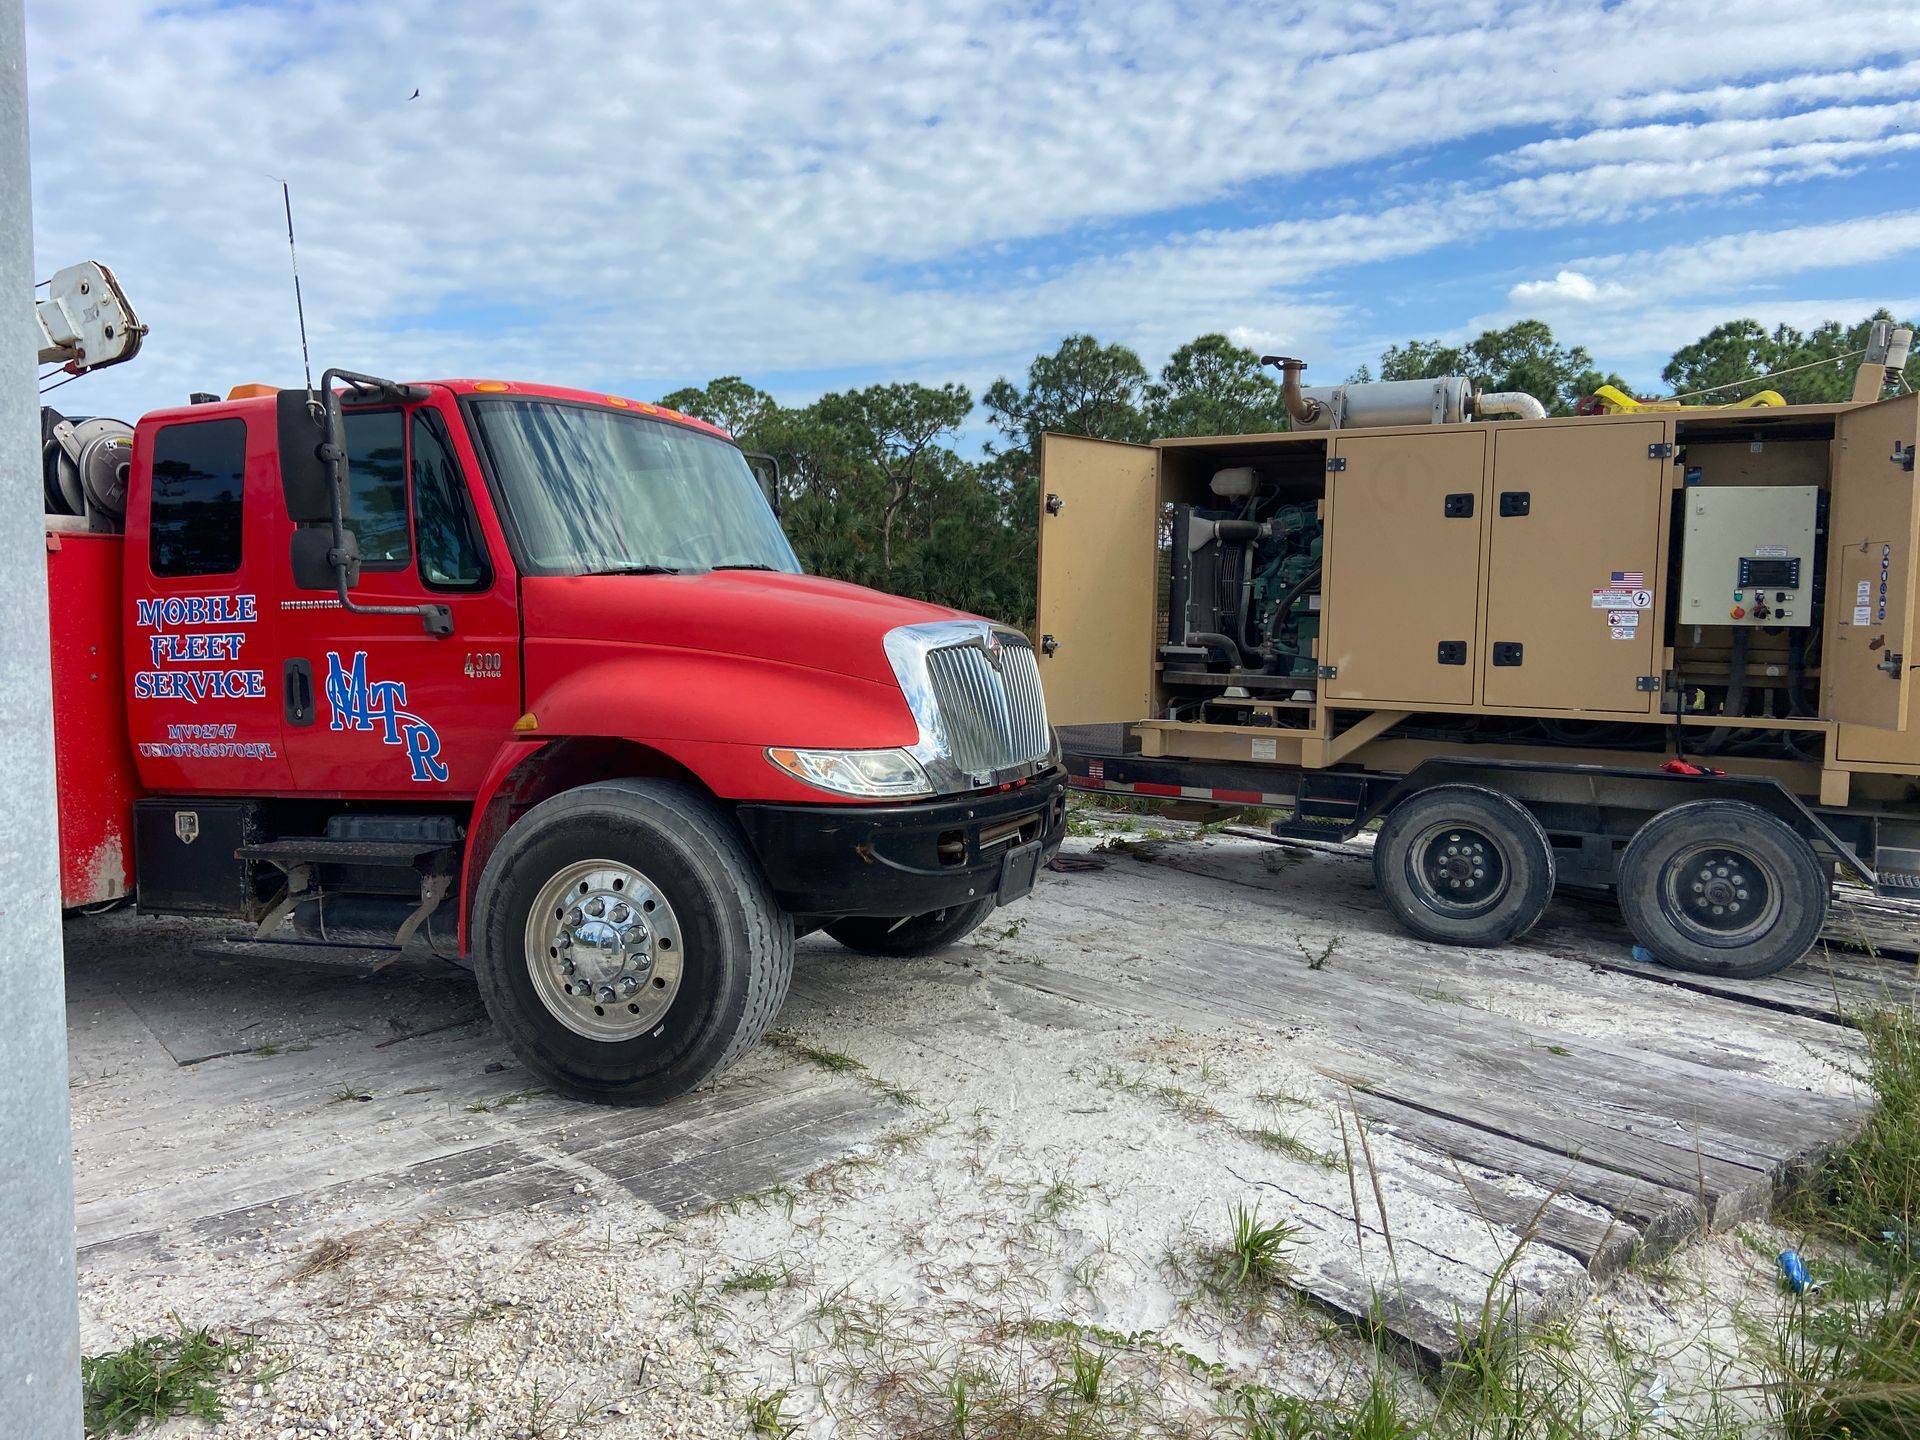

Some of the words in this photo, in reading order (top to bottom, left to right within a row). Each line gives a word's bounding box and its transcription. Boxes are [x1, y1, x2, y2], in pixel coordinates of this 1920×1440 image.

[137, 594, 257, 632] MOBILE
[150, 633, 245, 669] FLEET
[464, 652, 501, 678] 4300
[134, 670, 266, 704] SERVICE
[476, 670, 502, 678] DT466
[167, 723, 237, 742] MV92747
